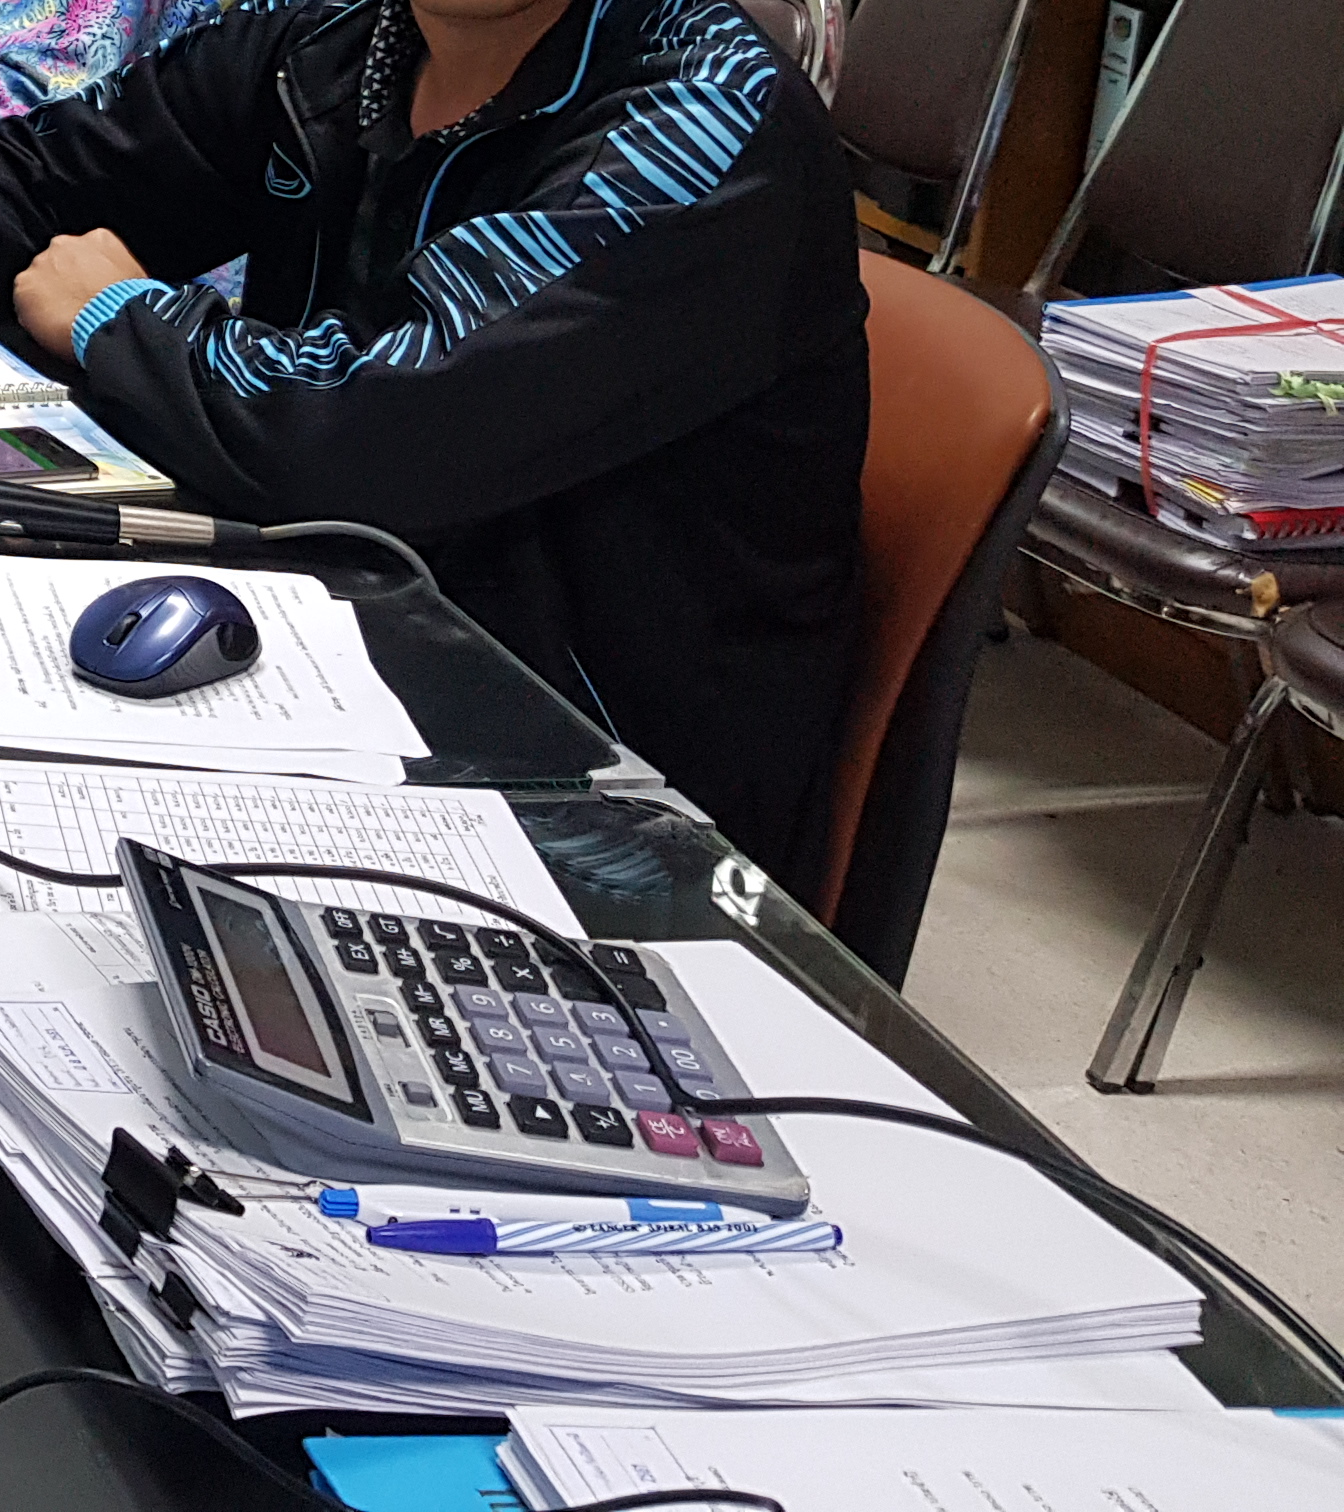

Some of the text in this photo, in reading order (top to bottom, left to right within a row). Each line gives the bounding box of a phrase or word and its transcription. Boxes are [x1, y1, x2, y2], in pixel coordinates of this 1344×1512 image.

[332, 909, 354, 928] OFF
[378, 917, 400, 934] GT
[348, 943, 370, 960] EX
[396, 948, 418, 967] M+
[471, 993, 497, 1007] 9
[529, 1001, 555, 1015] 6
[191, 983, 227, 1047] CASIO
[591, 1011, 617, 1024] 3
[428, 1017, 452, 1037] MR
[489, 1028, 513, 1041] 8
[549, 1036, 576, 1049] 5
[611, 1045, 637, 1059] 2
[670, 1049, 701, 1071] 00
[445, 1051, 472, 1074] MC
[506, 1063, 533, 1076] 7
[632, 1084, 657, 1095] 1
[463, 1090, 490, 1114] MU
